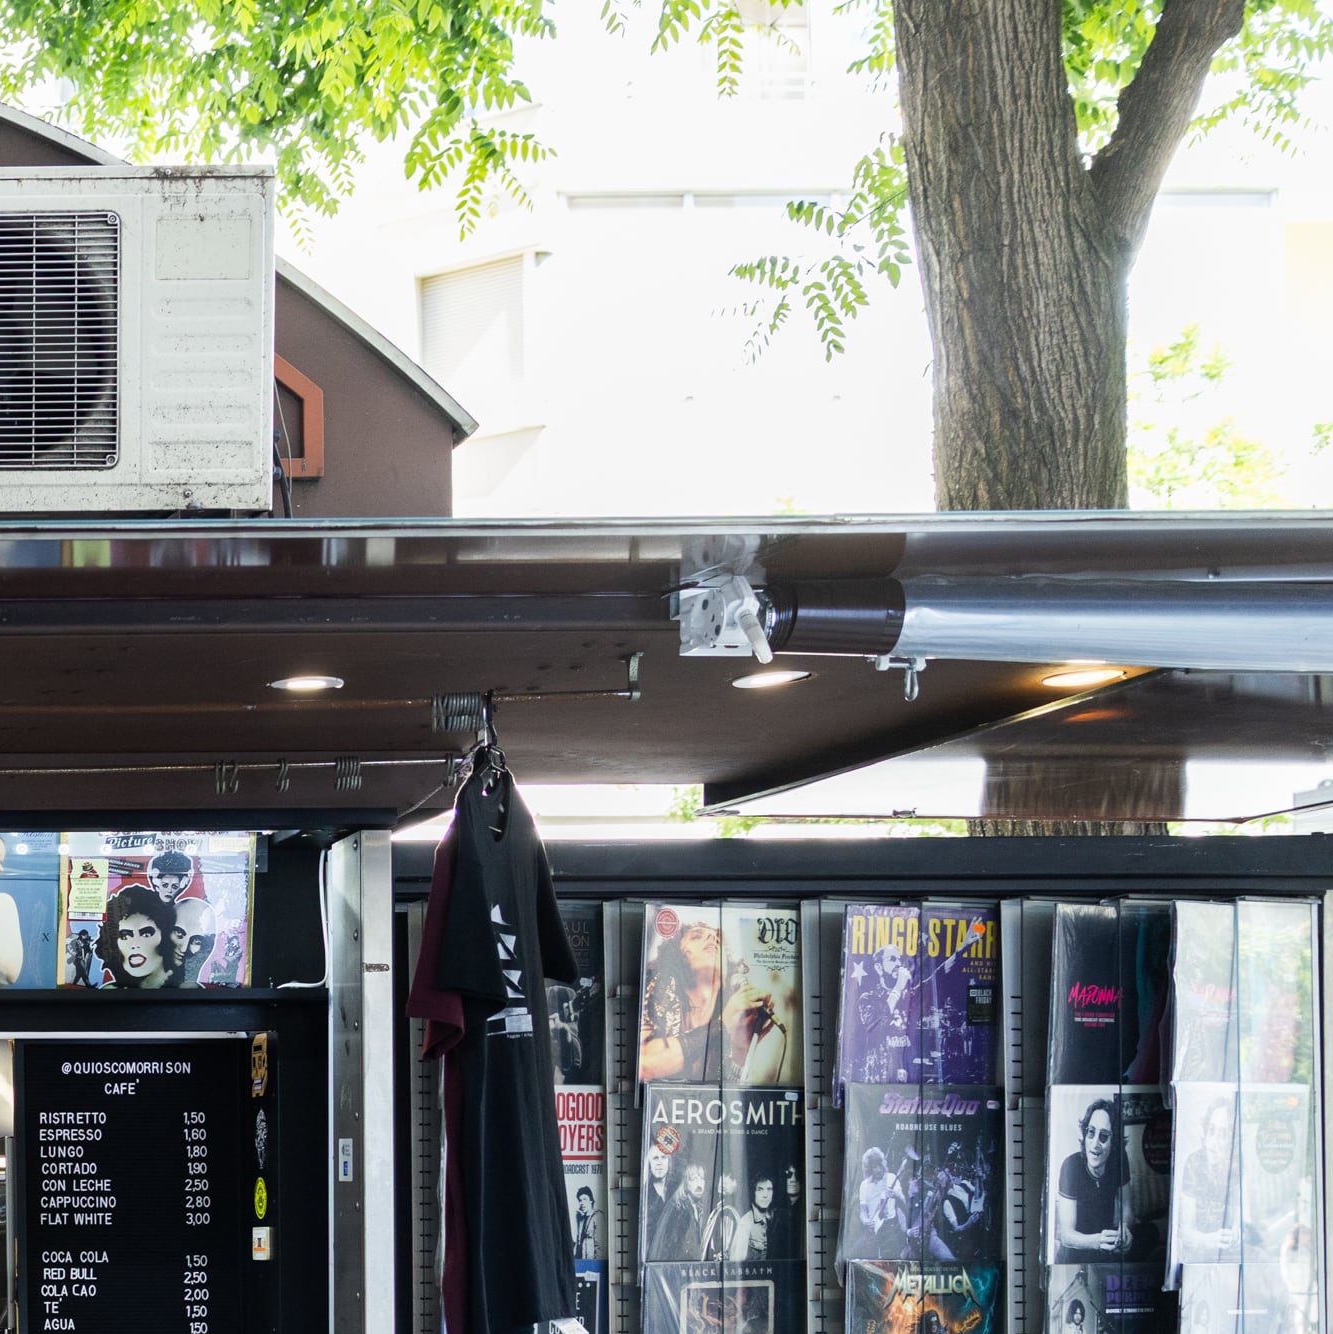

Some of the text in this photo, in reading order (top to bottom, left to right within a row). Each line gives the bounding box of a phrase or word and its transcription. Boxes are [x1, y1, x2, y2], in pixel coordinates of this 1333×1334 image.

[106, 836, 154, 849] Picture
[851, 915, 920, 956] RINGO
[39, 1112, 206, 1125] RISTRETTO 1,50
[939, 1123, 963, 1132] BLUES
[39, 1128, 207, 1141] ESPRESSO 1,60
[40, 1145, 208, 1158] LUNGO 1,80
[41, 1162, 207, 1175] CORTADO 1,90
[42, 1179, 209, 1192] CON LECHE 2,50
[40, 1196, 210, 1209] CAPPUCCINO 2,80
[40, 1213, 210, 1226] FLAT WHITE 3,00
[41, 1251, 208, 1268] COCA COLA 1,50
[43, 1268, 207, 1284] RED BULL 2,50
[887, 1266, 981, 1304] METALLICA
[40, 1284, 209, 1301] COLA CAO 2,00
[185, 1305, 208, 1318] 1,50
[43, 1318, 208, 1334] AGUA 1,50
